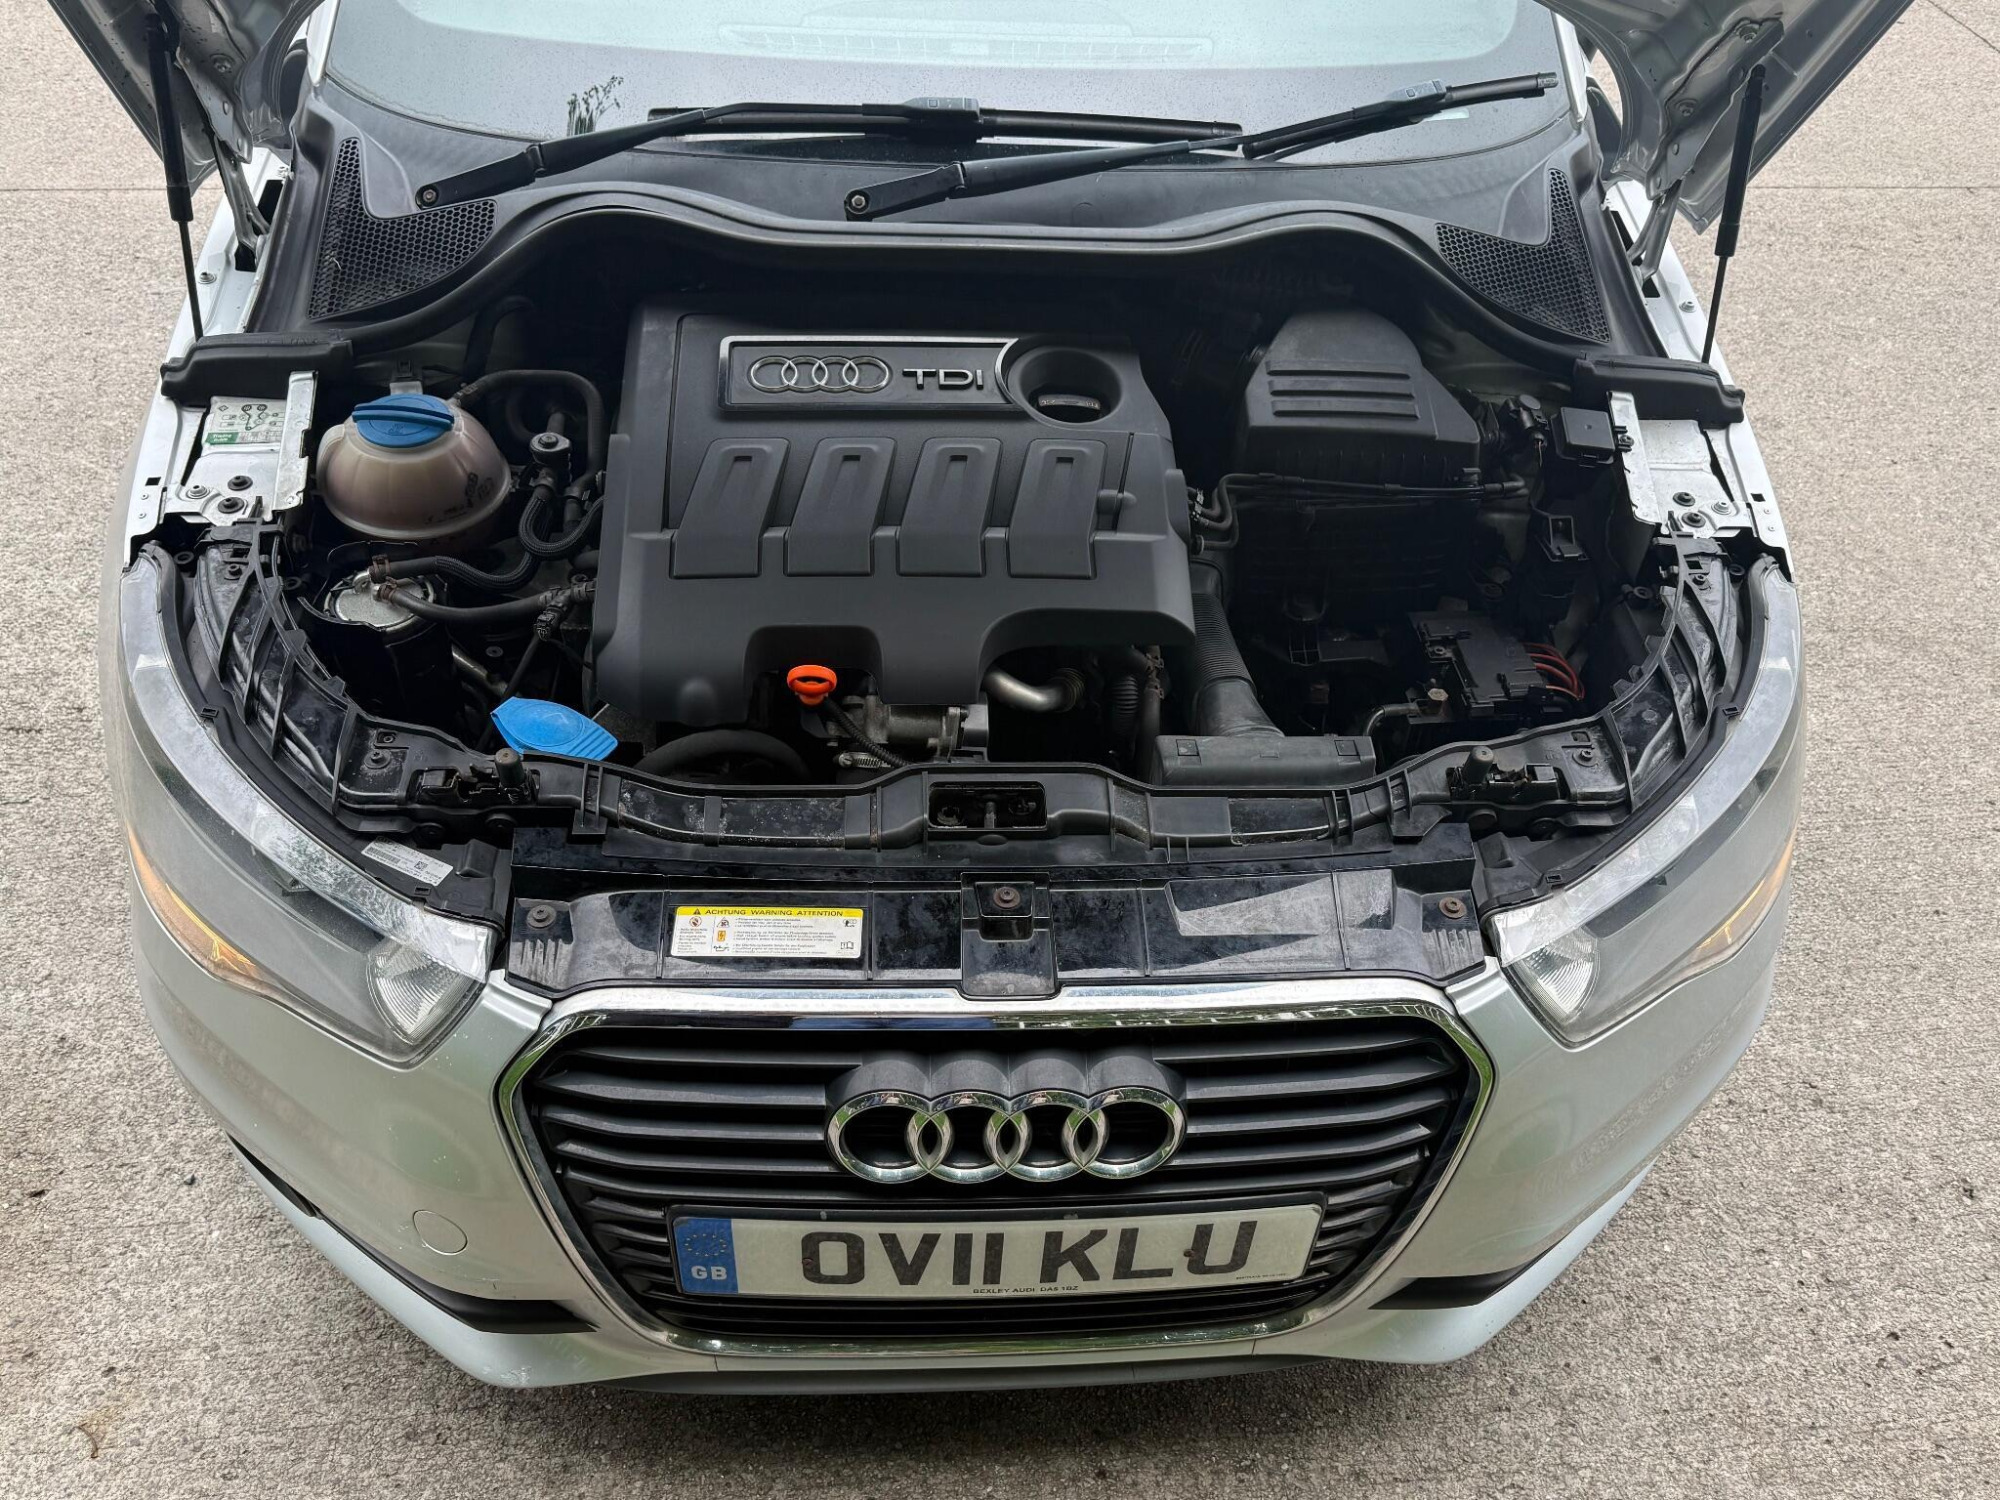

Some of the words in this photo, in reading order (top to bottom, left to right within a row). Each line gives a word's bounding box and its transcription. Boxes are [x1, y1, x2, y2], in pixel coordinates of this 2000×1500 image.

[902, 367, 984, 390] TDI
[1039, 1220, 1258, 1283] KLU
[690, 1265, 727, 1281] GB
